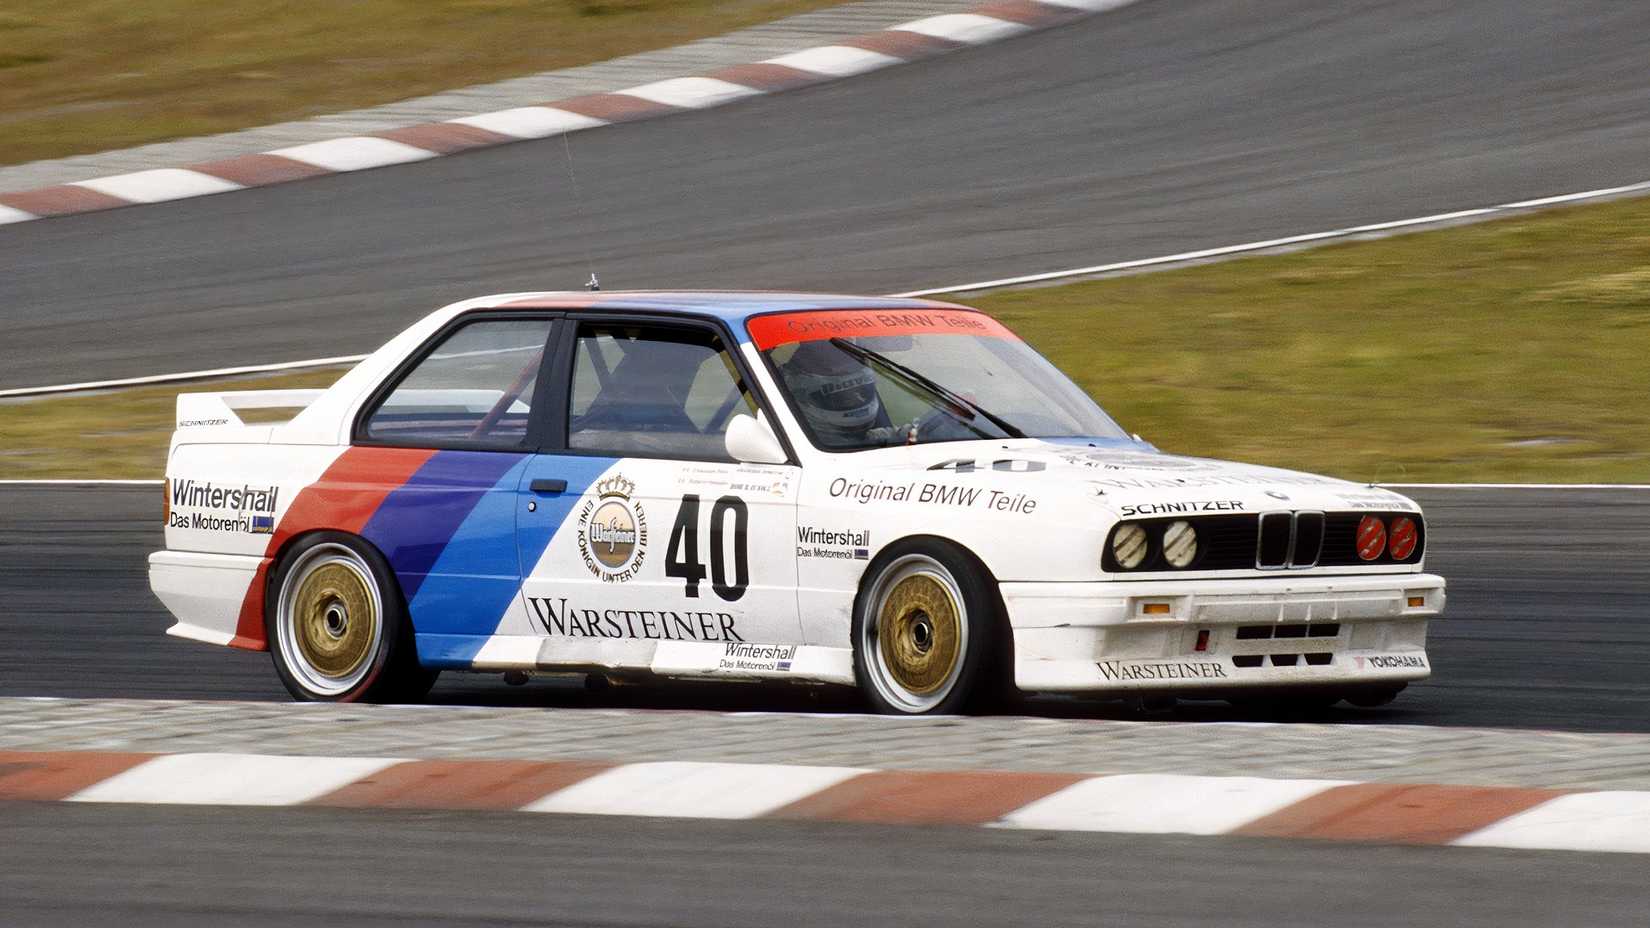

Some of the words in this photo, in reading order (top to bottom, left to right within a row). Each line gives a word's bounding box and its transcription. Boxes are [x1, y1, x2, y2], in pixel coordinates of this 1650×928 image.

[787, 315, 872, 333] Original
[882, 314, 935, 328] BMW
[937, 315, 987, 330] Teile
[173, 478, 279, 512] Wintershall
[829, 477, 915, 504] Original
[919, 483, 982, 507] BMW
[987, 490, 1037, 514] Teile
[1121, 500, 1244, 516] SCHNITZER
[170, 511, 189, 528] Das
[192, 512, 250, 533] Motorenöl
[578, 500, 595, 527] EINE
[602, 569, 633, 583] UNTER
[631, 550, 645, 573] DEN
[798, 526, 870, 546] Wintershall
[665, 494, 749, 601] 40
[797, 547, 811, 557] Das
[725, 642, 798, 660] Wintershall
[719, 658, 734, 668] Das
